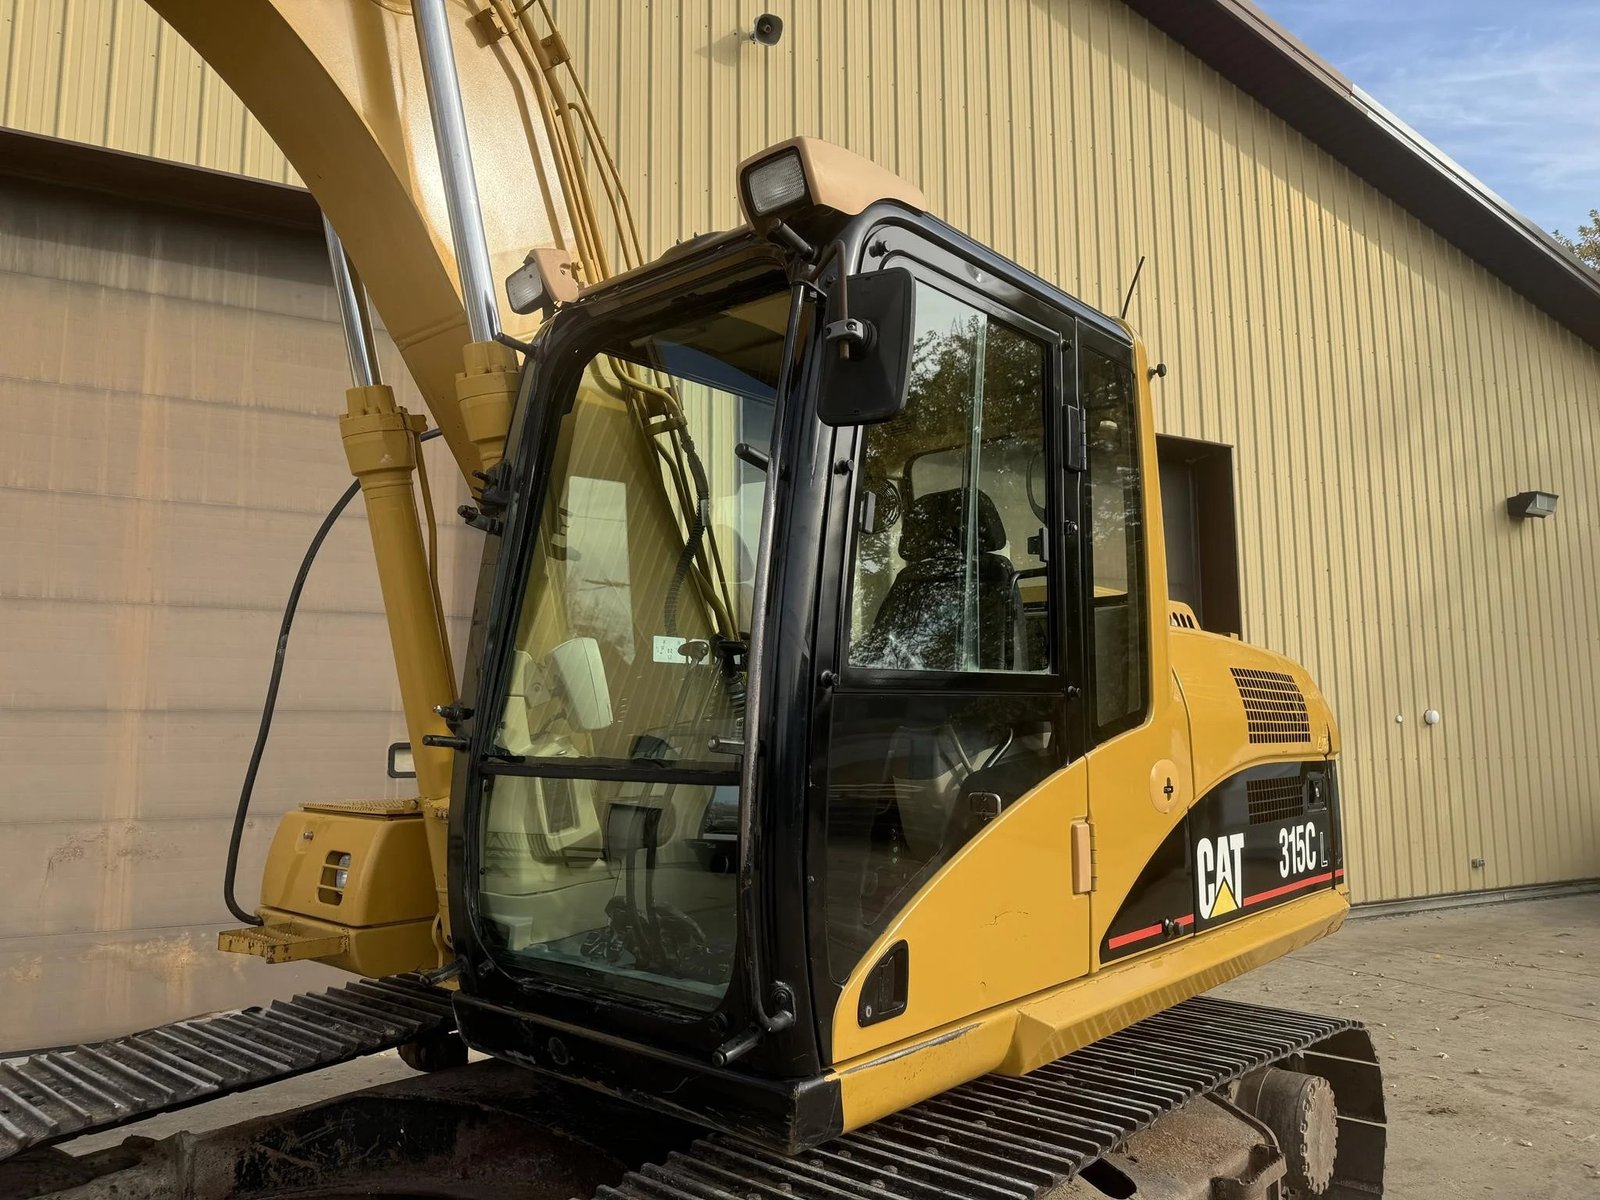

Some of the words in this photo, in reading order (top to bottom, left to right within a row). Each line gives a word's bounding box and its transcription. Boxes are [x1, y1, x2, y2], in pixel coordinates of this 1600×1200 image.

[1197, 833, 1245, 920] CAT
[1279, 822, 1316, 878] 315C
[1320, 832, 1328, 867] L
